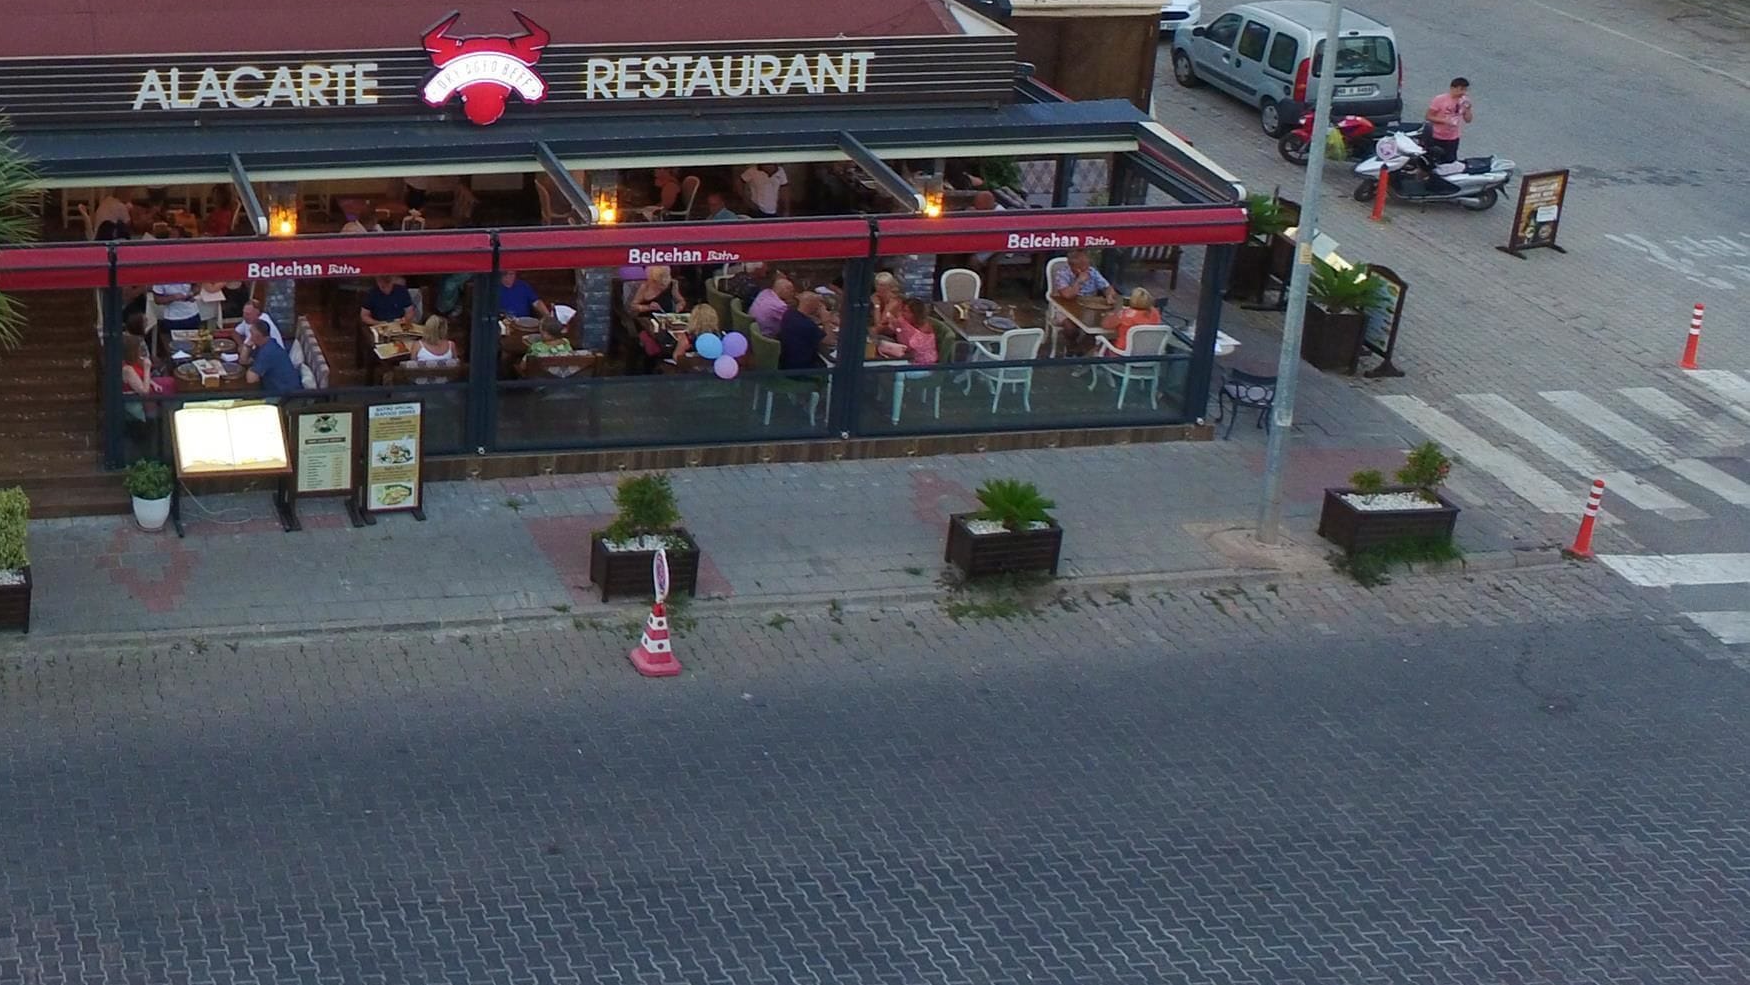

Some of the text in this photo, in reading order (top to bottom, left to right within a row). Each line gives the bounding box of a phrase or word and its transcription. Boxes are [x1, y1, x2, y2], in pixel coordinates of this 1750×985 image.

[501, 63, 534, 88] BEEF
[586, 52, 875, 100] RESTAURANT
[132, 62, 379, 111] ALACARTE
[1006, 232, 1080, 249] Belcehan
[628, 247, 702, 264] Belcehan
[247, 260, 323, 278] Belcehan
